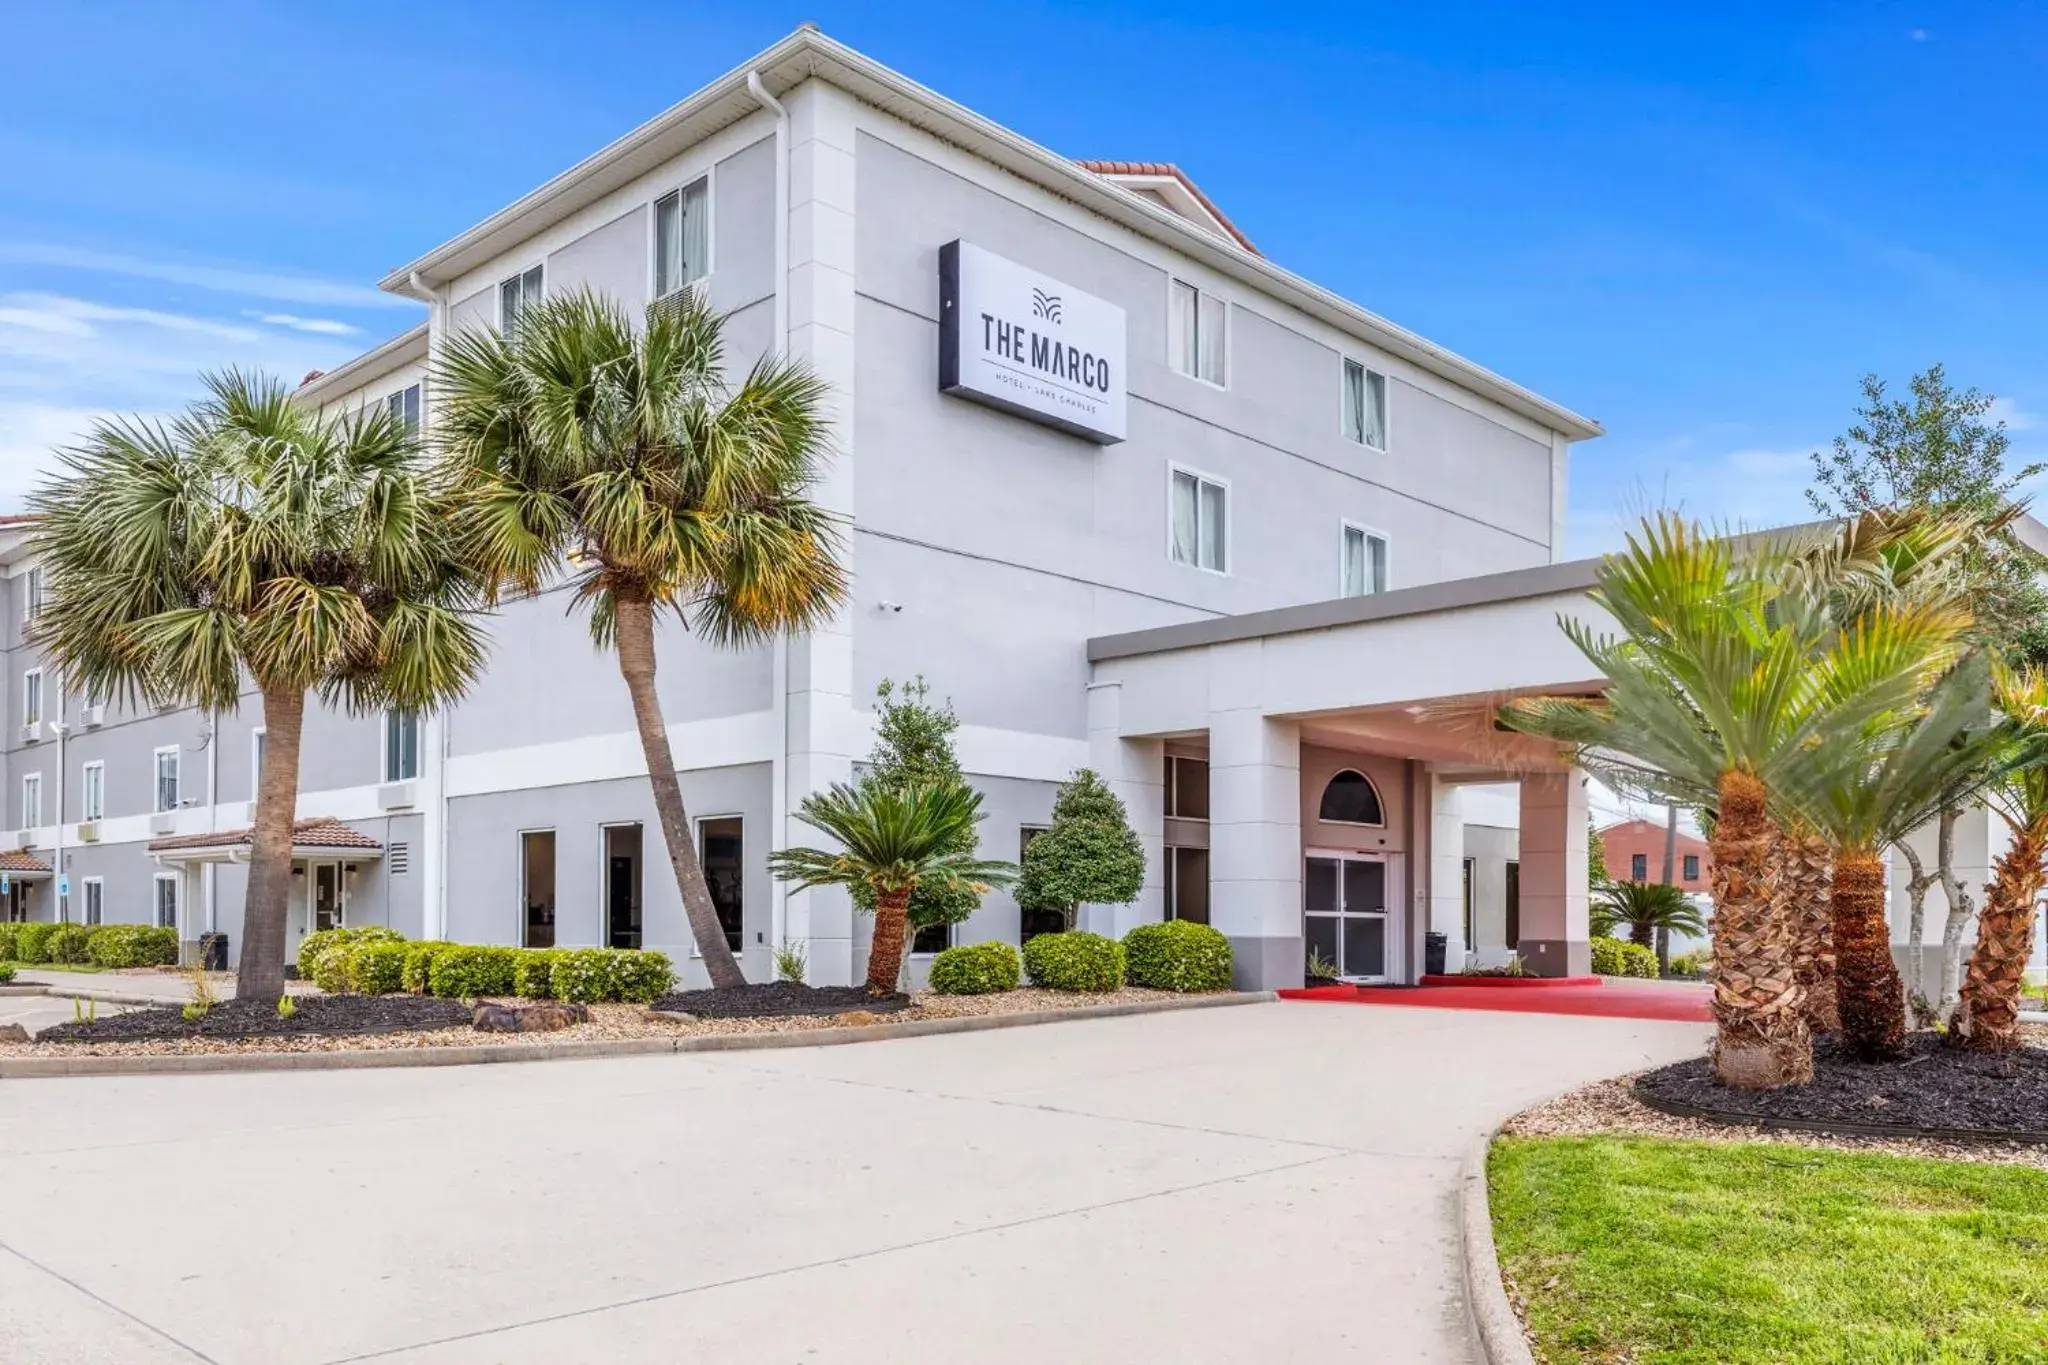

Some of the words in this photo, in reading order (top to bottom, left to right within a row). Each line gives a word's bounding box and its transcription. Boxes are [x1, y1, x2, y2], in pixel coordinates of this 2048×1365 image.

[981, 312, 1025, 364] THE
[1032, 332, 1109, 393] MARCO
[996, 373, 1023, 389] HOTEL
